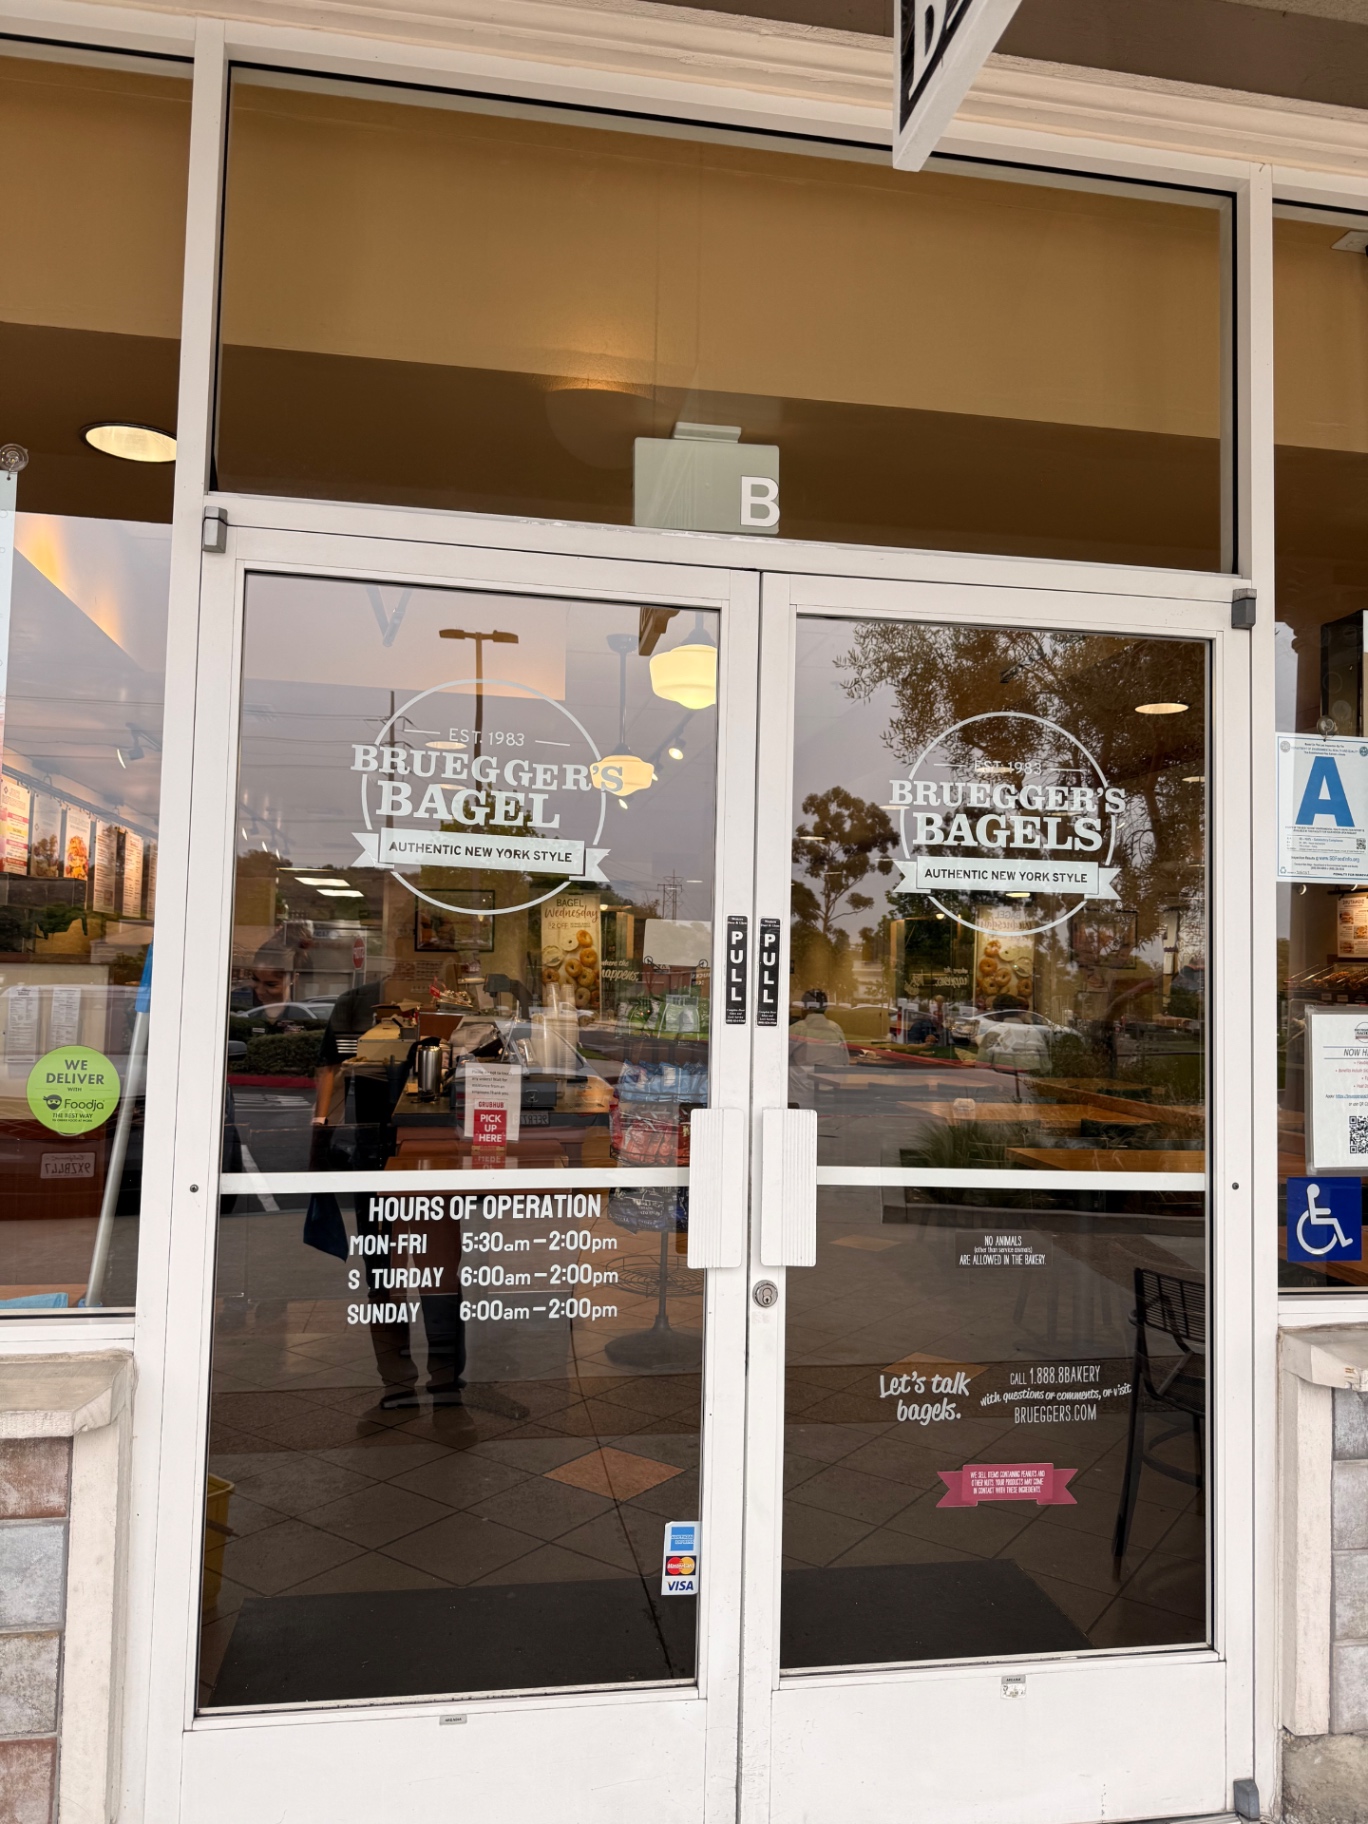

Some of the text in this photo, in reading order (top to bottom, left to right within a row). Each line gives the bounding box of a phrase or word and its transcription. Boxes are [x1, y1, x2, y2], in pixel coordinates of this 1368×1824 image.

[741, 475, 780, 527] B
[489, 732, 525, 746] 1983
[351, 744, 623, 792] BRUEGGER'S
[1008, 762, 1041, 775] 1983
[889, 779, 1126, 813] BRUEGGER'S
[1296, 756, 1355, 827] A
[376, 780, 560, 829] BAGEL
[912, 812, 1103, 852] BAGELS
[389, 842, 572, 863] AUTHENTIC NEW YORK STYLE
[924, 868, 1088, 883] AUTHENTIC NEW YORK STYLE
[556, 899, 584, 908] BAGEL
[544, 904, 599, 925] Wednesday
[730, 931, 744, 1001] PULL
[763, 934, 776, 1004] PULL
[1344, 1048, 1361, 1057] NOW
[65, 1060, 88, 1071] WE
[46, 1073, 105, 1085] DELIVER
[64, 1099, 104, 1112] Foodja
[478, 1101, 504, 1109] GRUBHUB
[480, 1114, 502, 1123] PICK
[484, 1124, 497, 1132] UP
[478, 1134, 502, 1143] HERE
[369, 1194, 601, 1222] HOURS OF OPERATION
[350, 1234, 427, 1256] MON-FRI
[984, 1236, 1022, 1247] NO ANIMALS
[959, 1254, 971, 1266] ARE
[973, 1254, 1002, 1266] ALLOWED
[1004, 1254, 1010, 1265] IN
[1012, 1254, 1023, 1265] THE
[347, 1302, 420, 1325] SUNDAY
[879, 1371, 971, 1398] Let's talk
[1010, 1366, 1100, 1385] CALL 1.888.8BAKERY
[980, 1383, 1132, 1407] with questions or comments, or visit
[897, 1398, 962, 1426] bagels.
[1014, 1404, 1097, 1424] BRUEGGERS.COM
[667, 1581, 694, 1591] VISA
